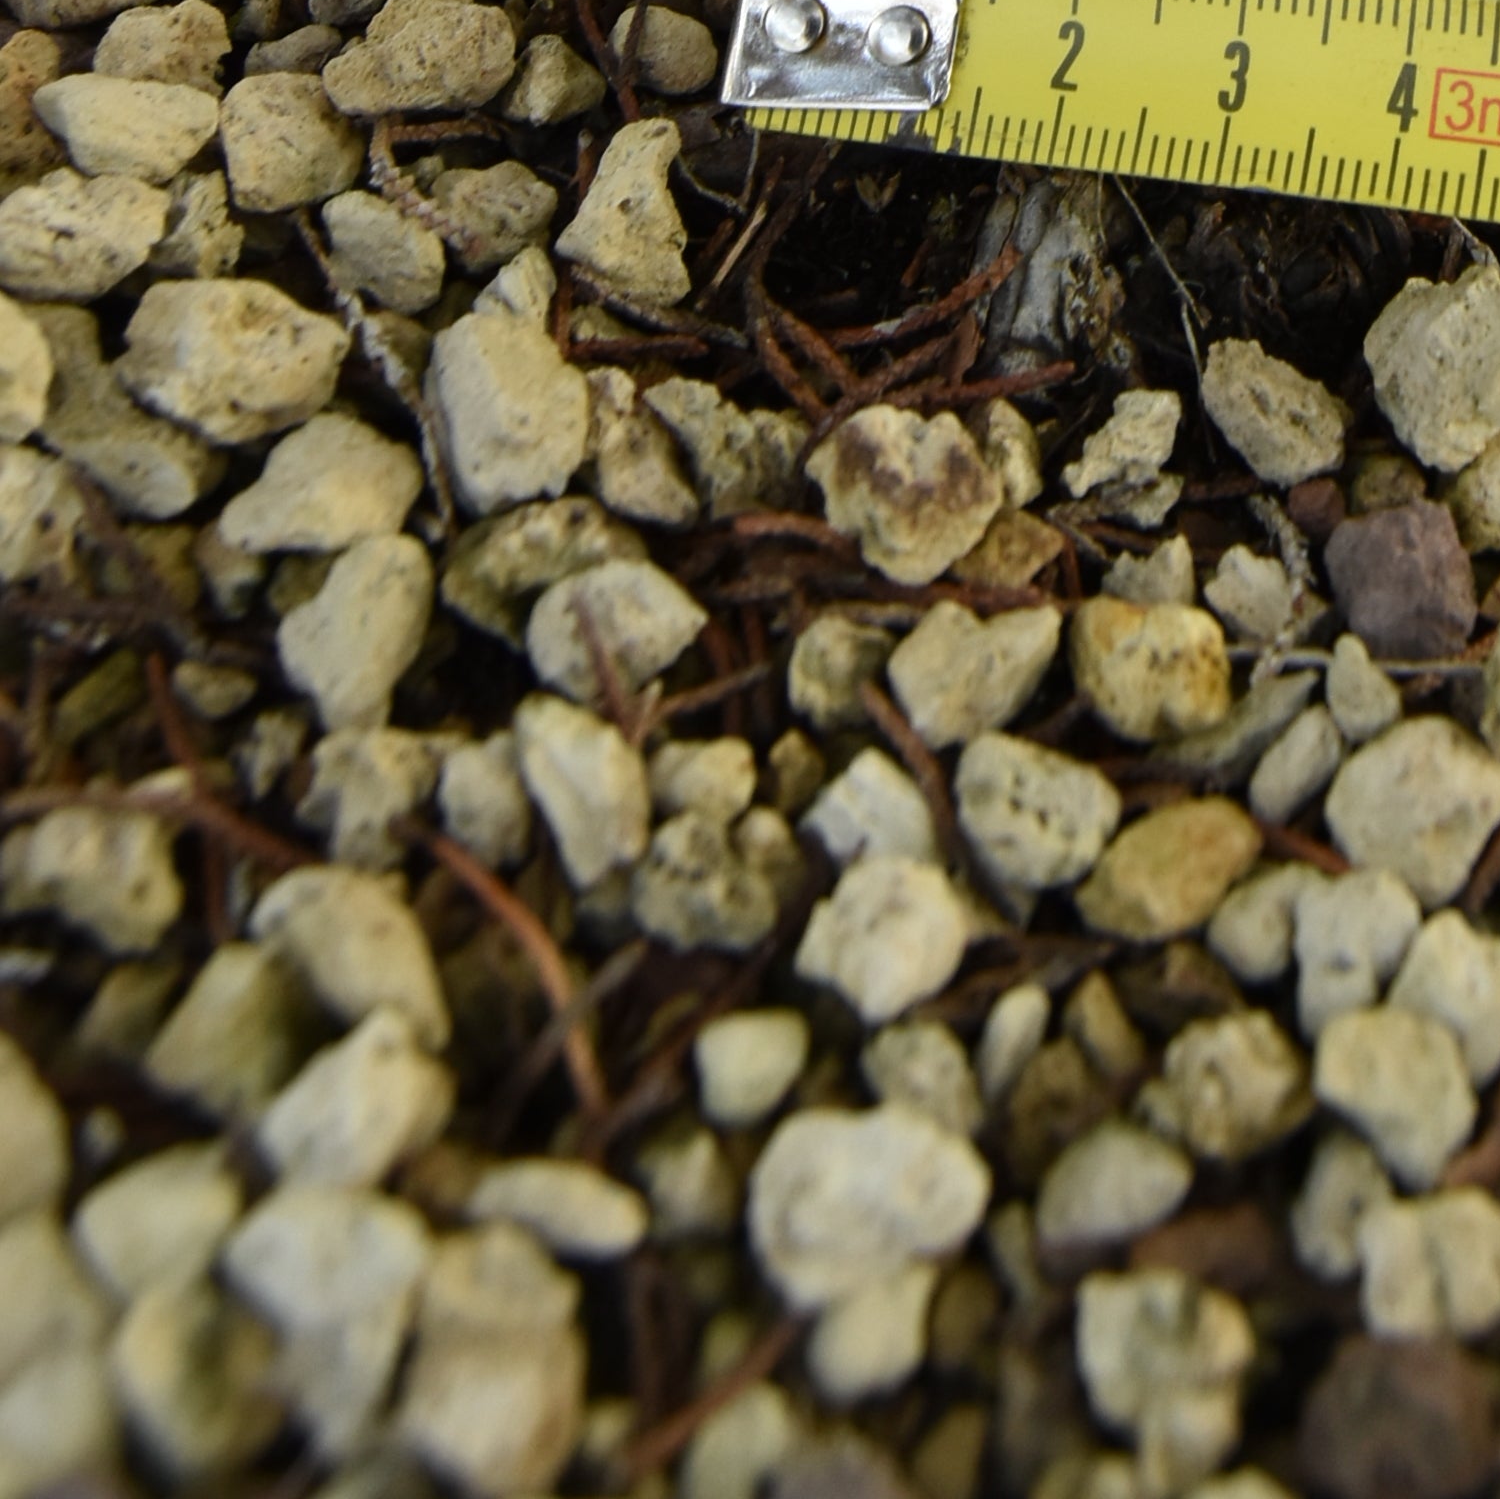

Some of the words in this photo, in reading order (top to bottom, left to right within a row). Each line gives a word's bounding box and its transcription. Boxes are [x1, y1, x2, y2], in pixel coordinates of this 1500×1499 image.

[1050, 20, 1086, 91] 2
[1217, 40, 1250, 113] 3
[1386, 62, 1418, 133] 4
